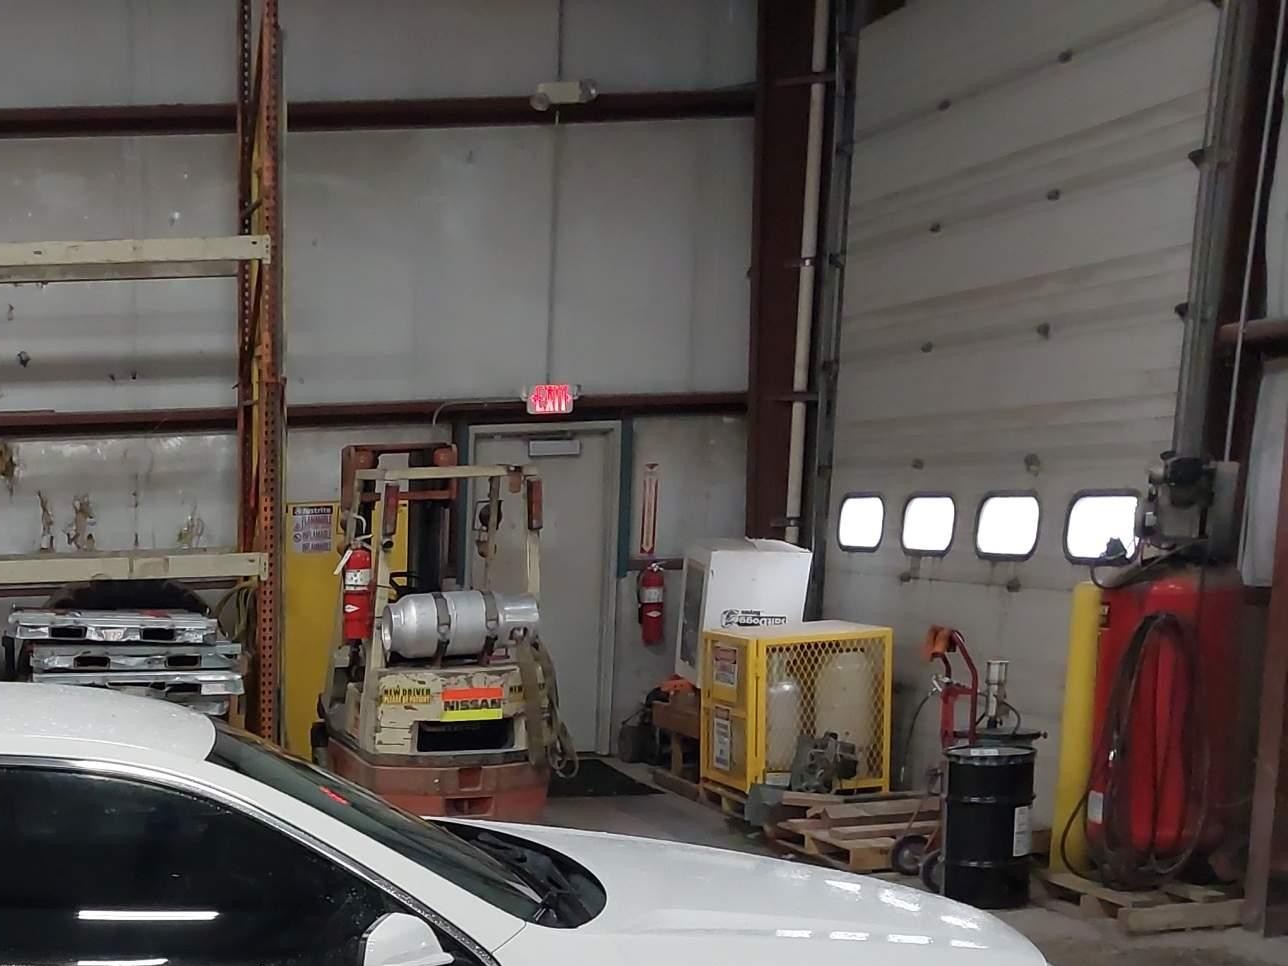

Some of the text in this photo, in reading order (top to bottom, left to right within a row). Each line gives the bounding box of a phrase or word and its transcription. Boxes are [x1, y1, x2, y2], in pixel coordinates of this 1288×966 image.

[535, 384, 569, 412] EXIT
[384, 687, 431, 697] NEW DRIVER
[443, 698, 502, 711] NISSAN
